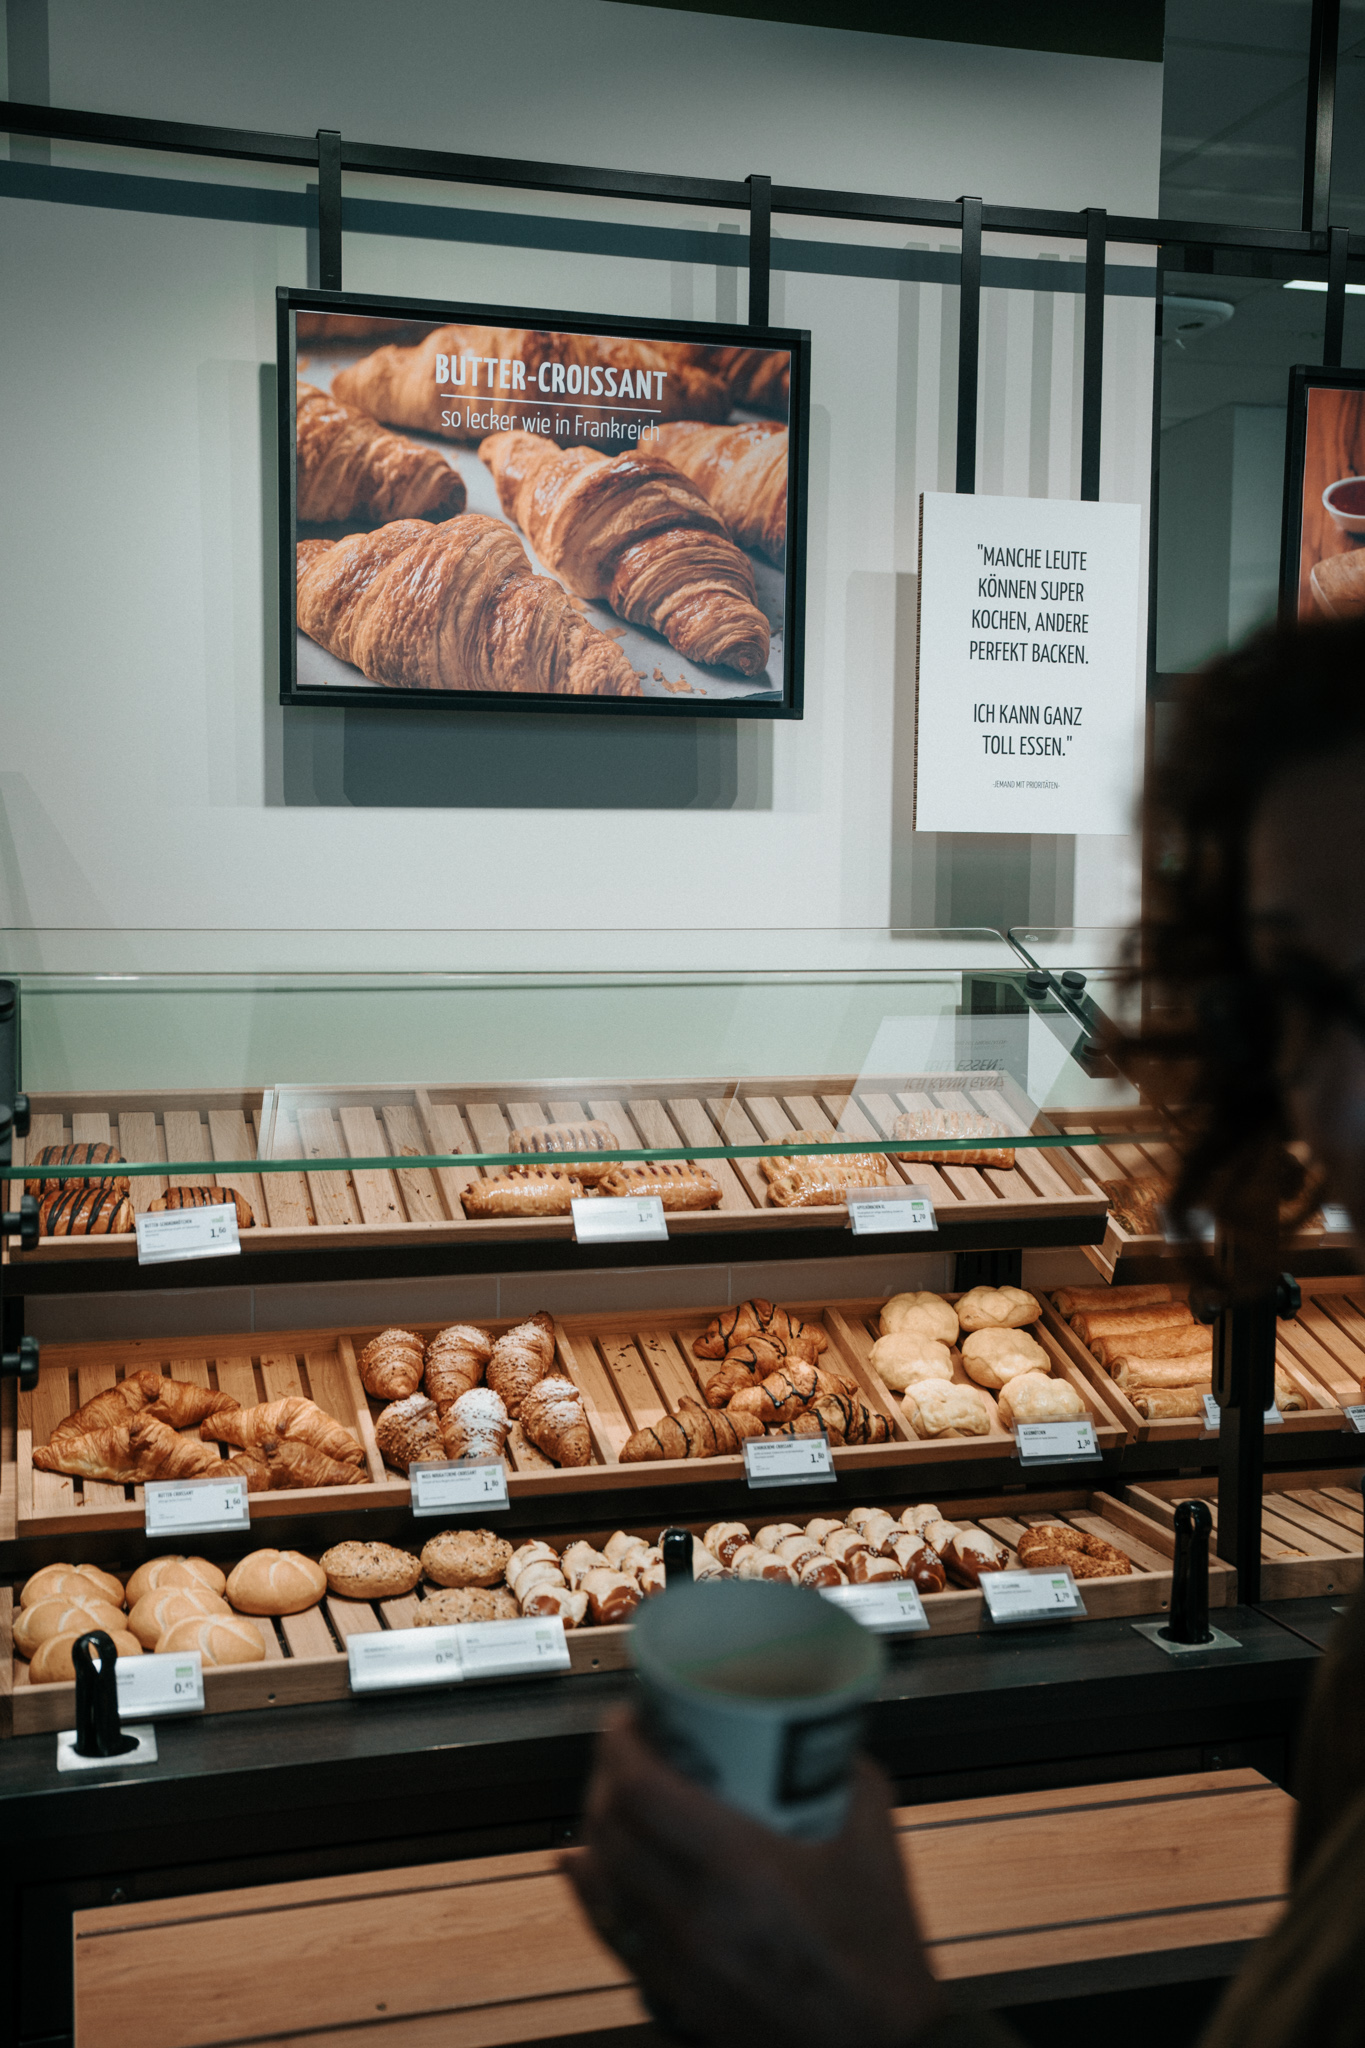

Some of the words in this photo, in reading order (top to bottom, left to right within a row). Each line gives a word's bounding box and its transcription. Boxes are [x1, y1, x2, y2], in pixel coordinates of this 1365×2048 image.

[435, 353, 668, 401] BUTTER-CROISSANT
[441, 410, 462, 428] so
[466, 406, 518, 431] lecker
[521, 411, 551, 434] wie
[555, 413, 570, 435] in
[574, 414, 660, 441] Frankreich
[977, 543, 1042, 569] "MANCHE
[1045, 549, 1088, 571] LEUTE
[978, 573, 1037, 600] KÖNNEN
[1040, 580, 1085, 602] SUPER
[971, 609, 1031, 634] KOCHEN,
[1034, 612, 1089, 634] ANDERE
[969, 640, 1029, 662] PERFEKT
[1031, 643, 1089, 665] BACKEN.
[973, 703, 995, 723] ICH
[999, 704, 1040, 725] KANN
[1043, 705, 1083, 726] GANZ
[982, 734, 1016, 755] TOLL
[1019, 735, 1073, 757] ESSEN."
[1015, 780, 1025, 789] MIT
